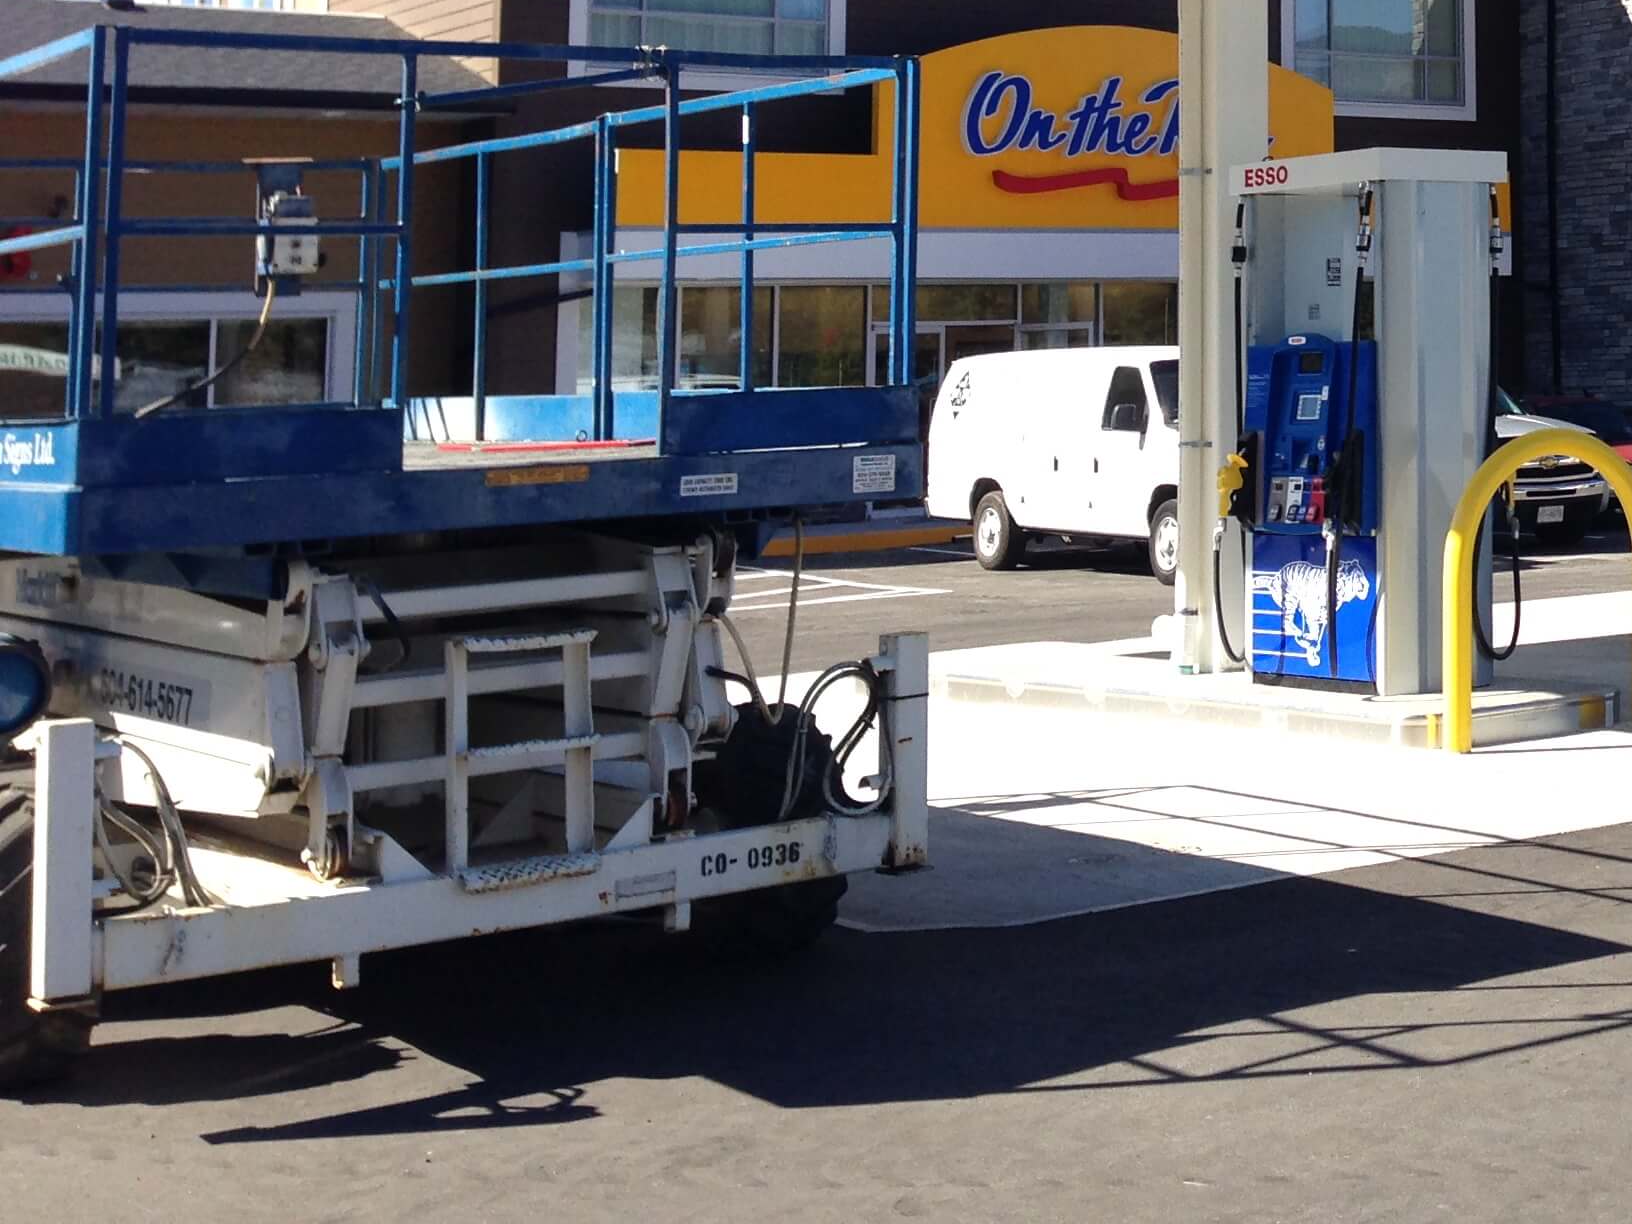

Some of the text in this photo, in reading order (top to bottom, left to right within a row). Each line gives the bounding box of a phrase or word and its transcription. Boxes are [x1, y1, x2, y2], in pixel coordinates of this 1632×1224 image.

[966, 72, 1067, 155] On
[1067, 77, 1157, 156] the
[1244, 165, 1288, 188] ESSO
[747, 841, 801, 870] 0936
